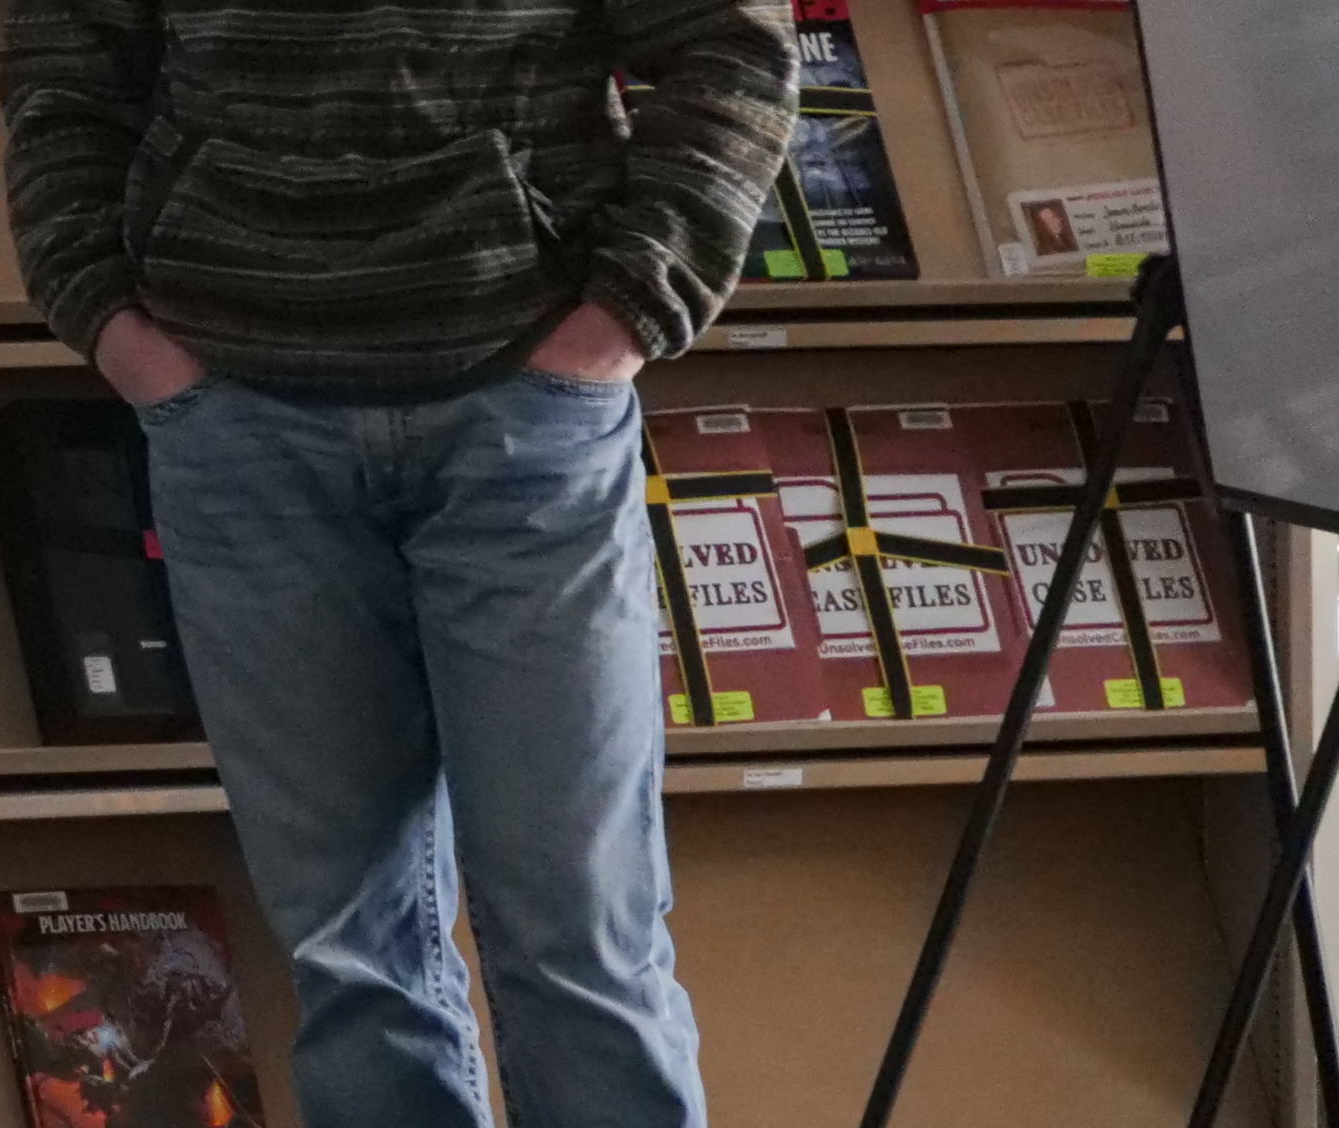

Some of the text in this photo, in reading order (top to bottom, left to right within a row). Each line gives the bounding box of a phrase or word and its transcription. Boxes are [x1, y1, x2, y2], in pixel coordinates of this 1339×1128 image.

[811, 583, 972, 613] CAS FILES
[1032, 576, 1196, 604] CSE LES
[108, 911, 188, 932] HANDBOOK
